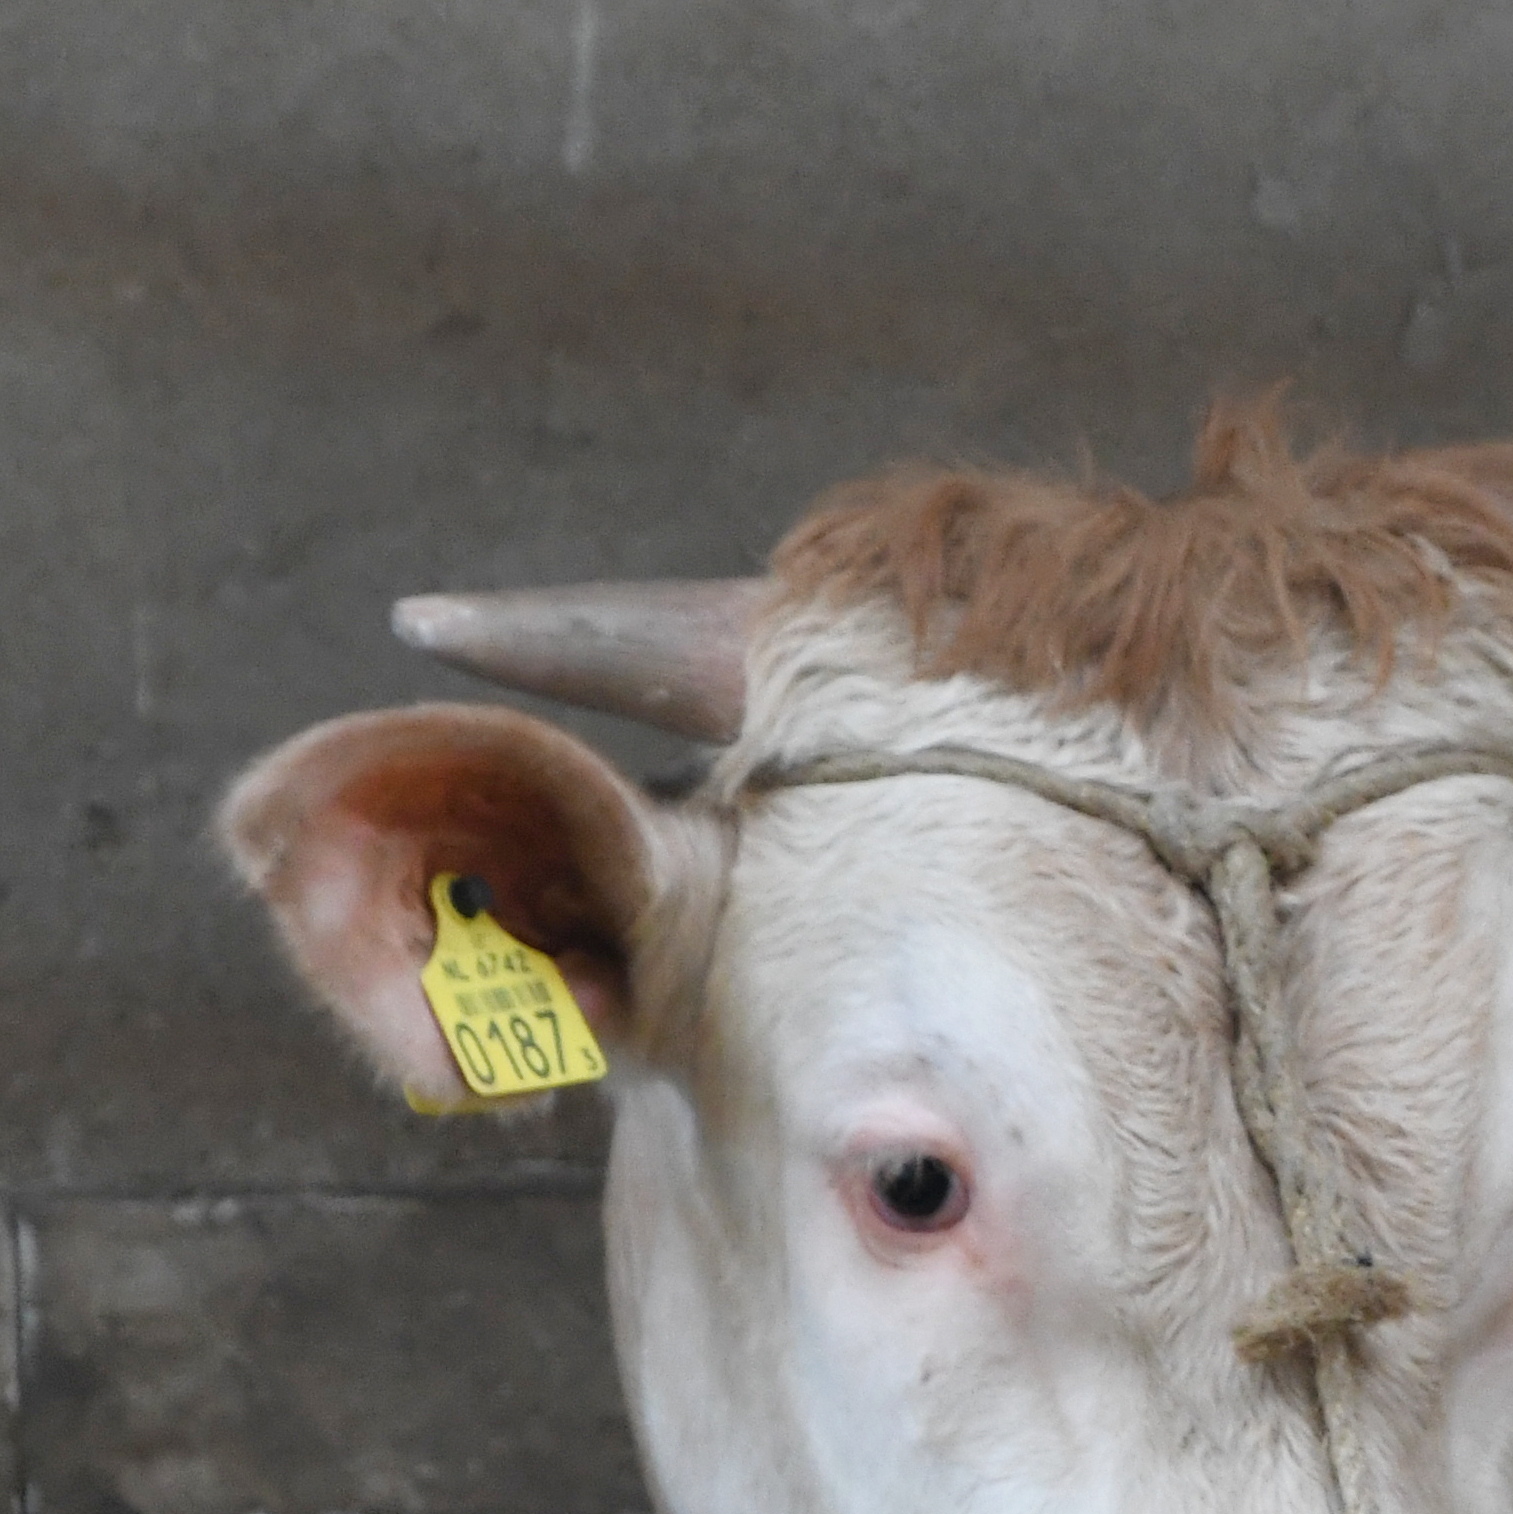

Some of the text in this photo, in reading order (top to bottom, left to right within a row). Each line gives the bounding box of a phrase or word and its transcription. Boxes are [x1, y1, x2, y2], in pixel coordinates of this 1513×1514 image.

[441, 950, 533, 981] NL 6742
[454, 1010, 566, 1086] 0187
